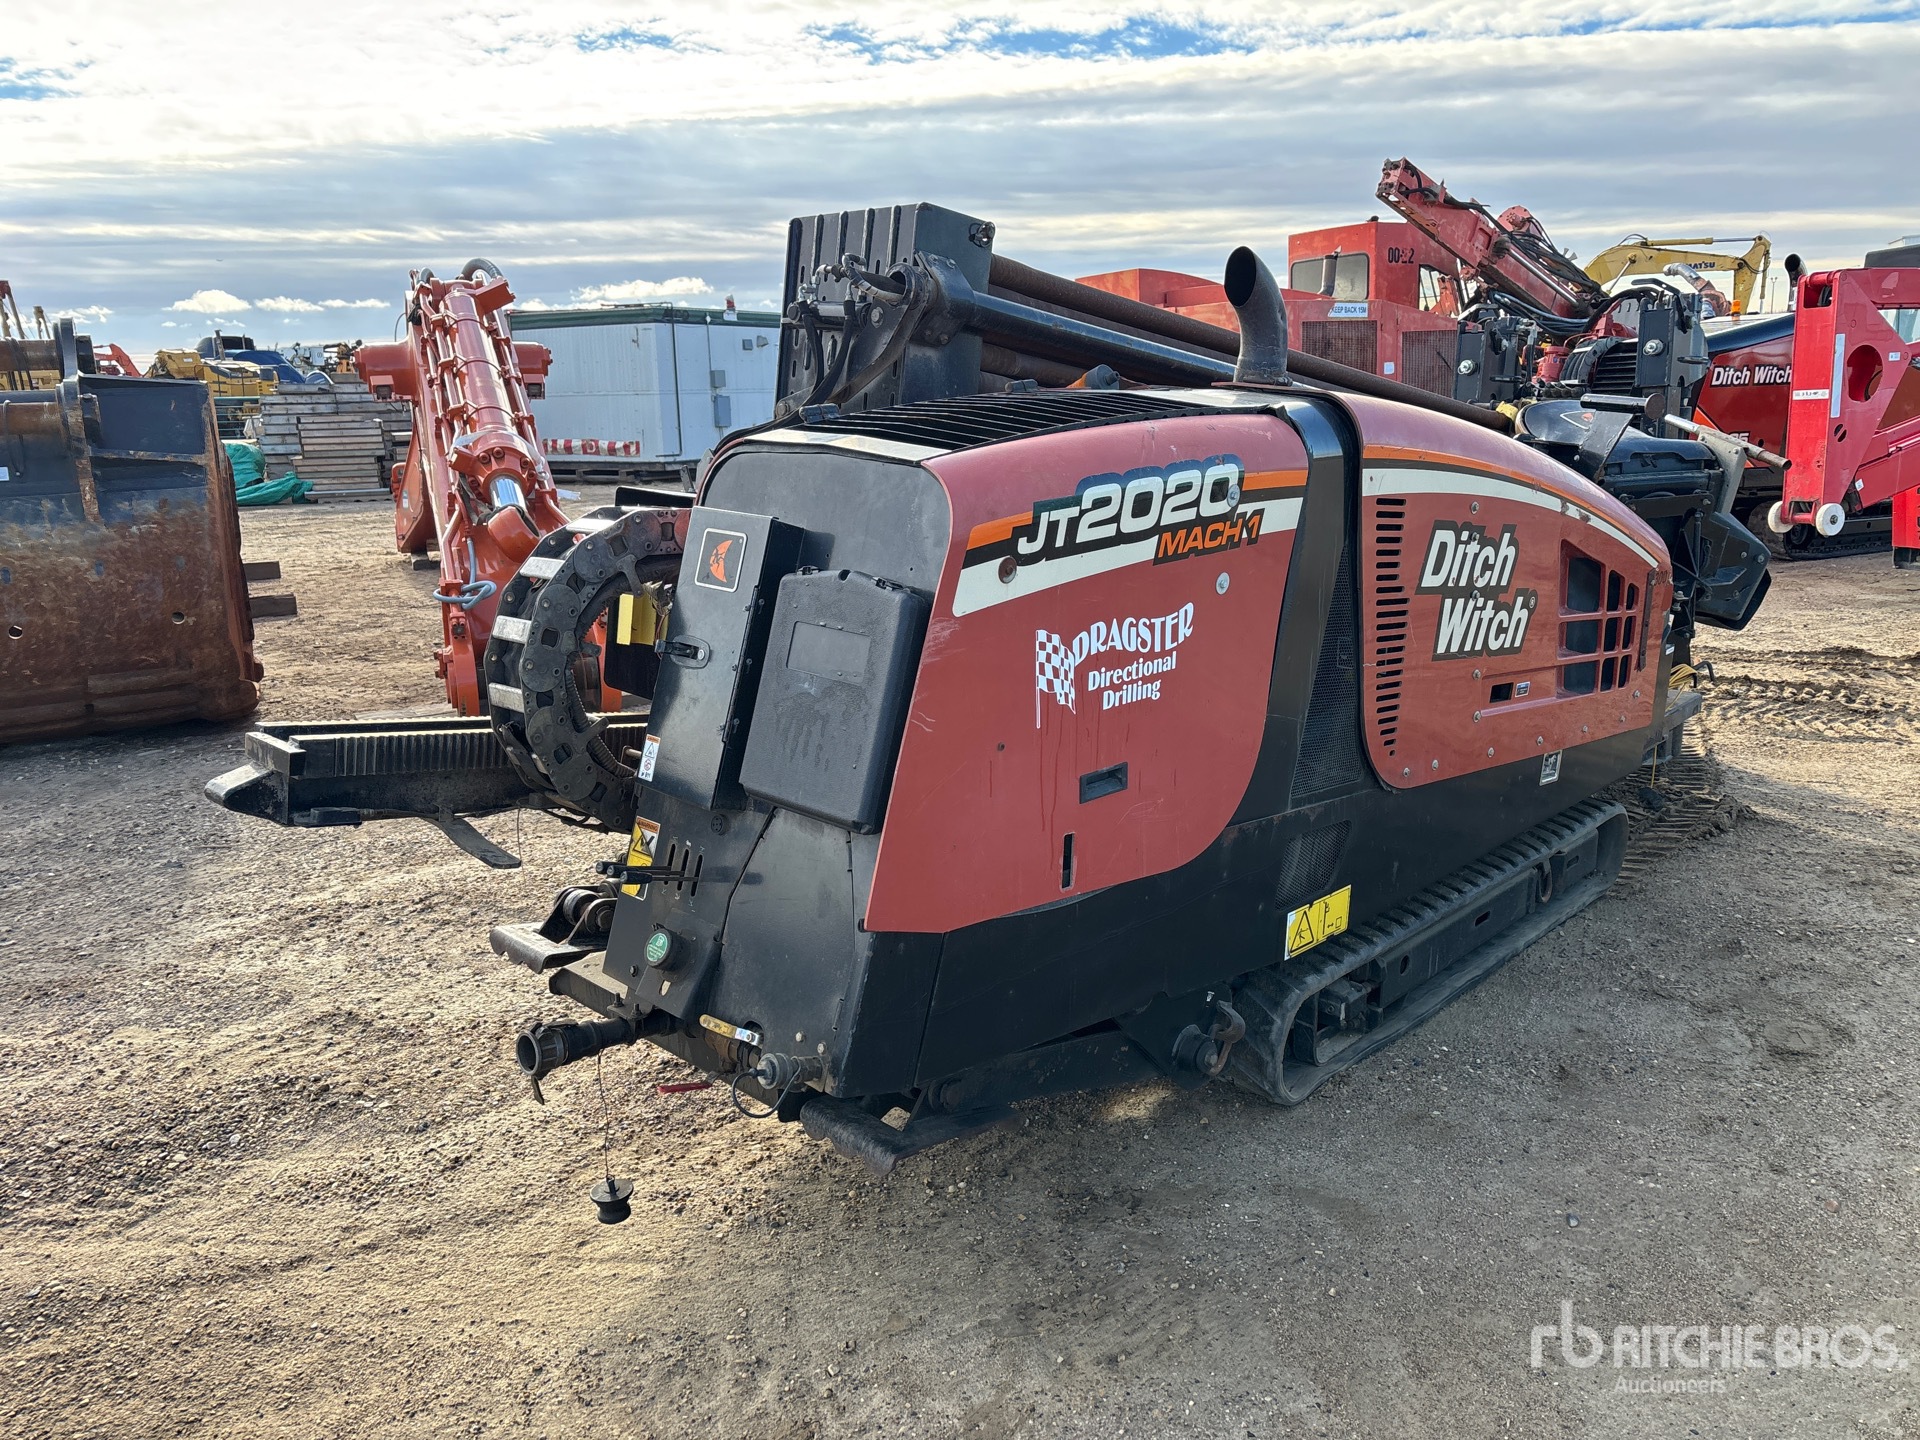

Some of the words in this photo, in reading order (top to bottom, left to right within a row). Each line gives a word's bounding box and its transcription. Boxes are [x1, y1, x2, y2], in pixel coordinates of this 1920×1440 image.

[1344, 306, 1357, 314] BACK
[1711, 366, 1751, 386] Ditch
[1753, 365, 1792, 385] Witch
[1017, 463, 1240, 555] JT2020
[1158, 517, 1243, 558] MACH
[1247, 514, 1260, 539] 1
[1421, 529, 1516, 588] Ditch
[1072, 602, 1194, 667] DRAGSTER
[1088, 651, 1177, 691] Directional
[1102, 679, 1162, 711] Drilling
